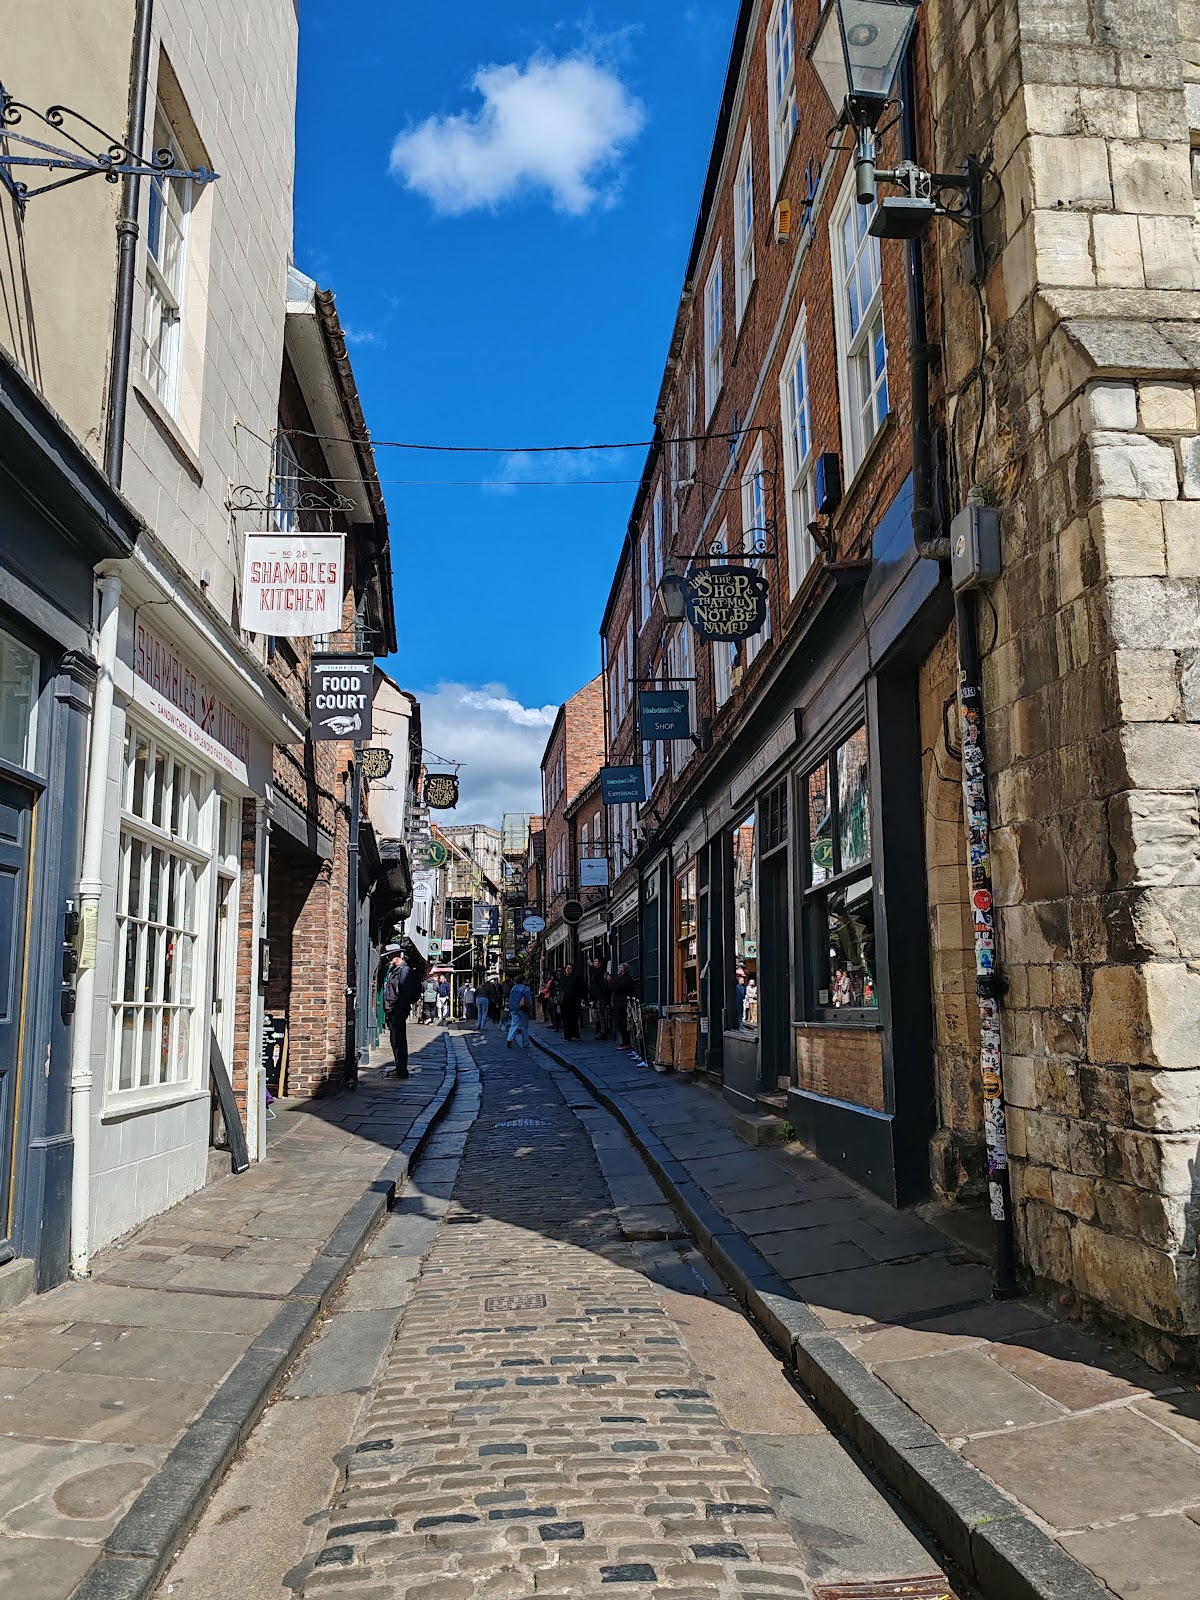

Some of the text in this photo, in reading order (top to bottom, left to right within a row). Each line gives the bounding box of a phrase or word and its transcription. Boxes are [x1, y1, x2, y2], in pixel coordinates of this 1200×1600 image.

[296, 550, 308, 558] 28
[251, 561, 337, 585] SHAMBLES
[712, 572, 735, 586] THE
[697, 575, 749, 598] SHOP
[260, 588, 327, 612] KITCHEN
[692, 584, 759, 615] THAT MUST
[693, 605, 757, 625] NOT BE
[703, 621, 749, 635] NAMED
[137, 624, 197, 721] SHAMBLES
[322, 676, 361, 692] FOOD
[315, 694, 368, 710] COURT
[157, 703, 188, 735] SANDWICHES
[189, 727, 193, 738] &
[654, 722, 675, 731] SHOP
[218, 701, 250, 768] KITCHEN
